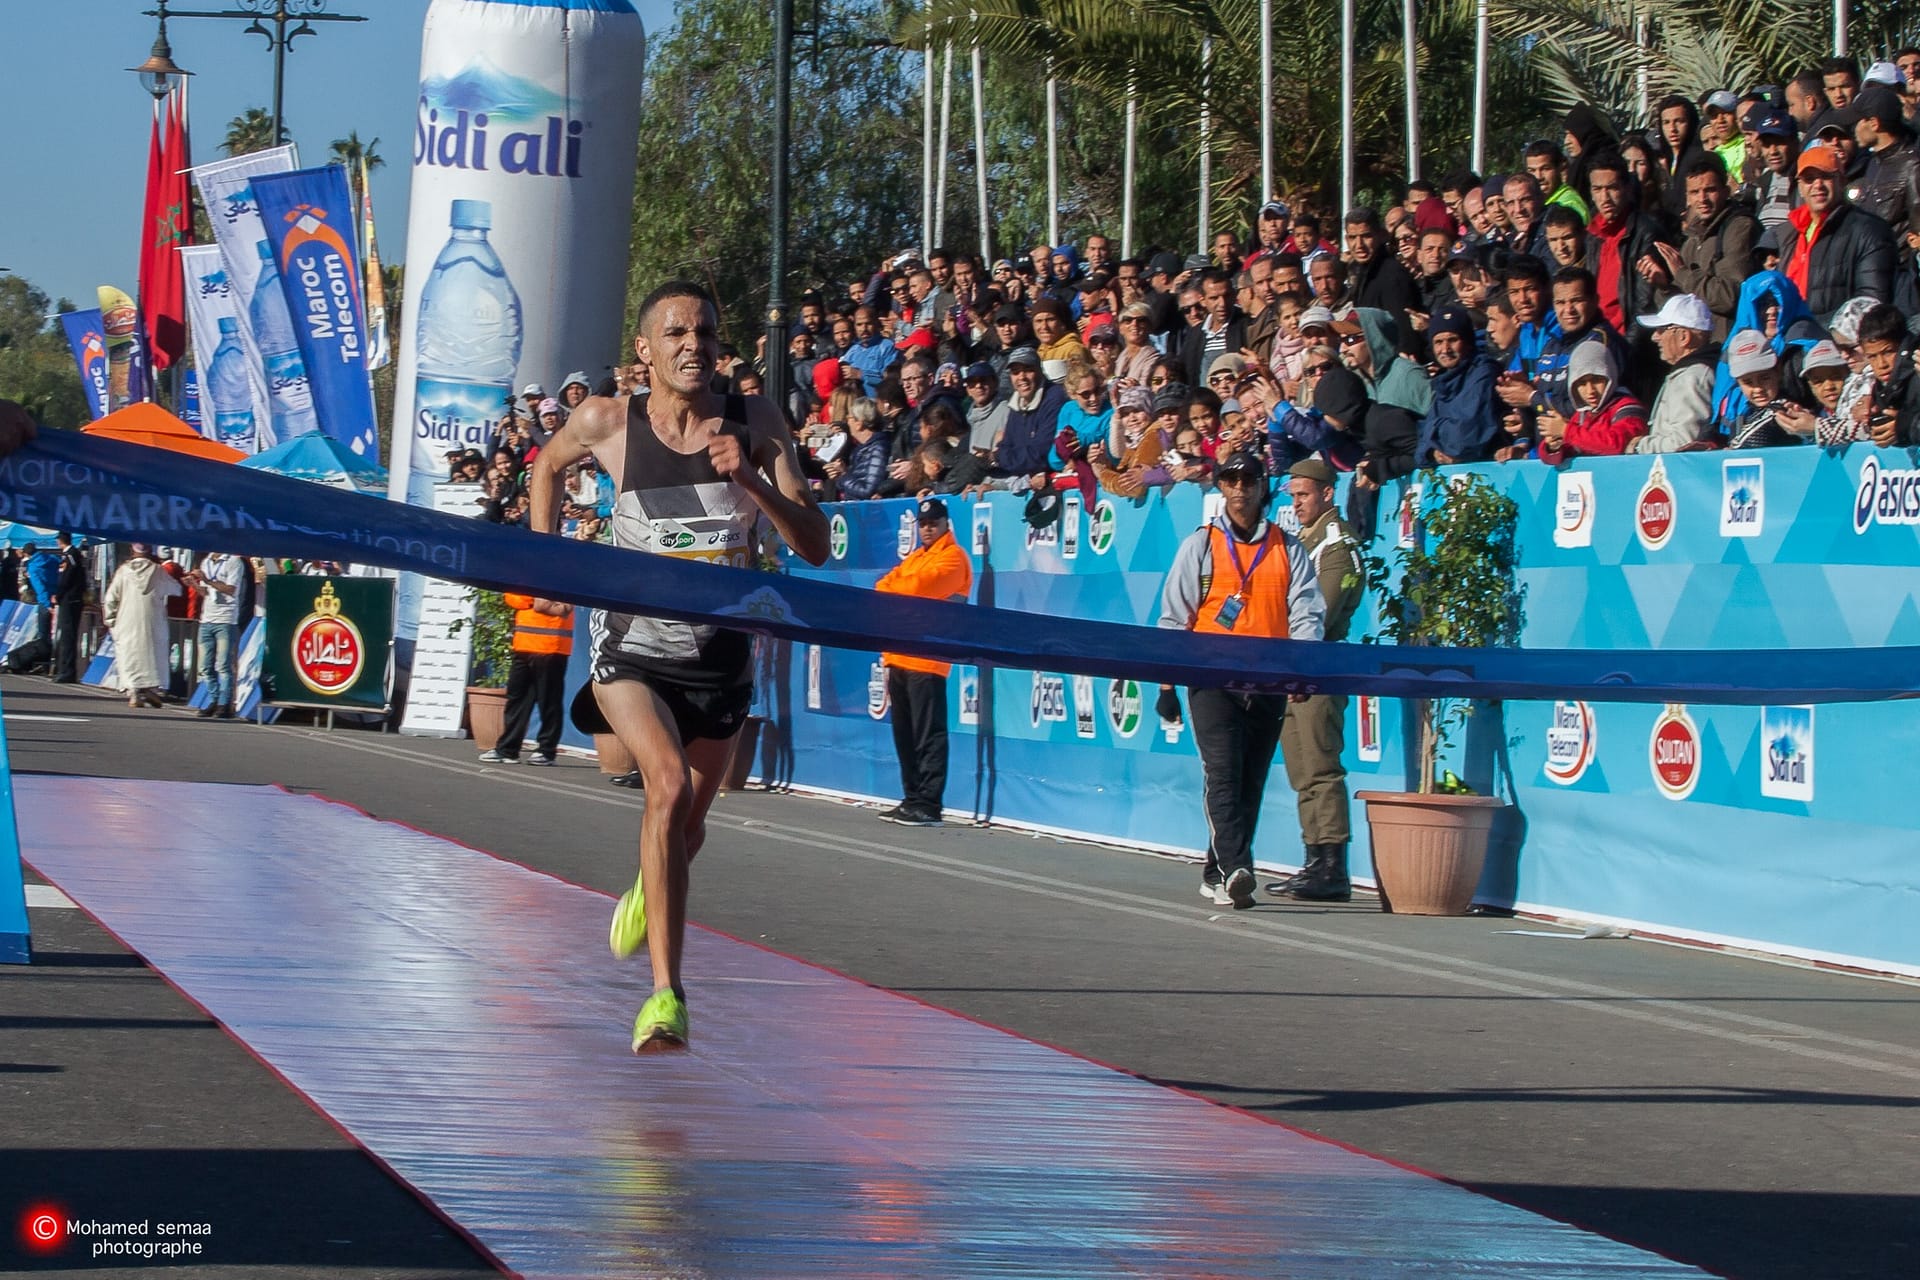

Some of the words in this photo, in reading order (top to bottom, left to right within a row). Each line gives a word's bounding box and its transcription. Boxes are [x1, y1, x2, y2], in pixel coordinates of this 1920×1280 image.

[414, 94, 489, 170] Sidi
[500, 116, 583, 178] ali
[296, 256, 335, 339] Maroc
[323, 253, 361, 364] Telecom
[416, 408, 461, 441] Sidi
[1877, 475, 1920, 518] asics
[1656, 737, 1695, 766] SULTAN
